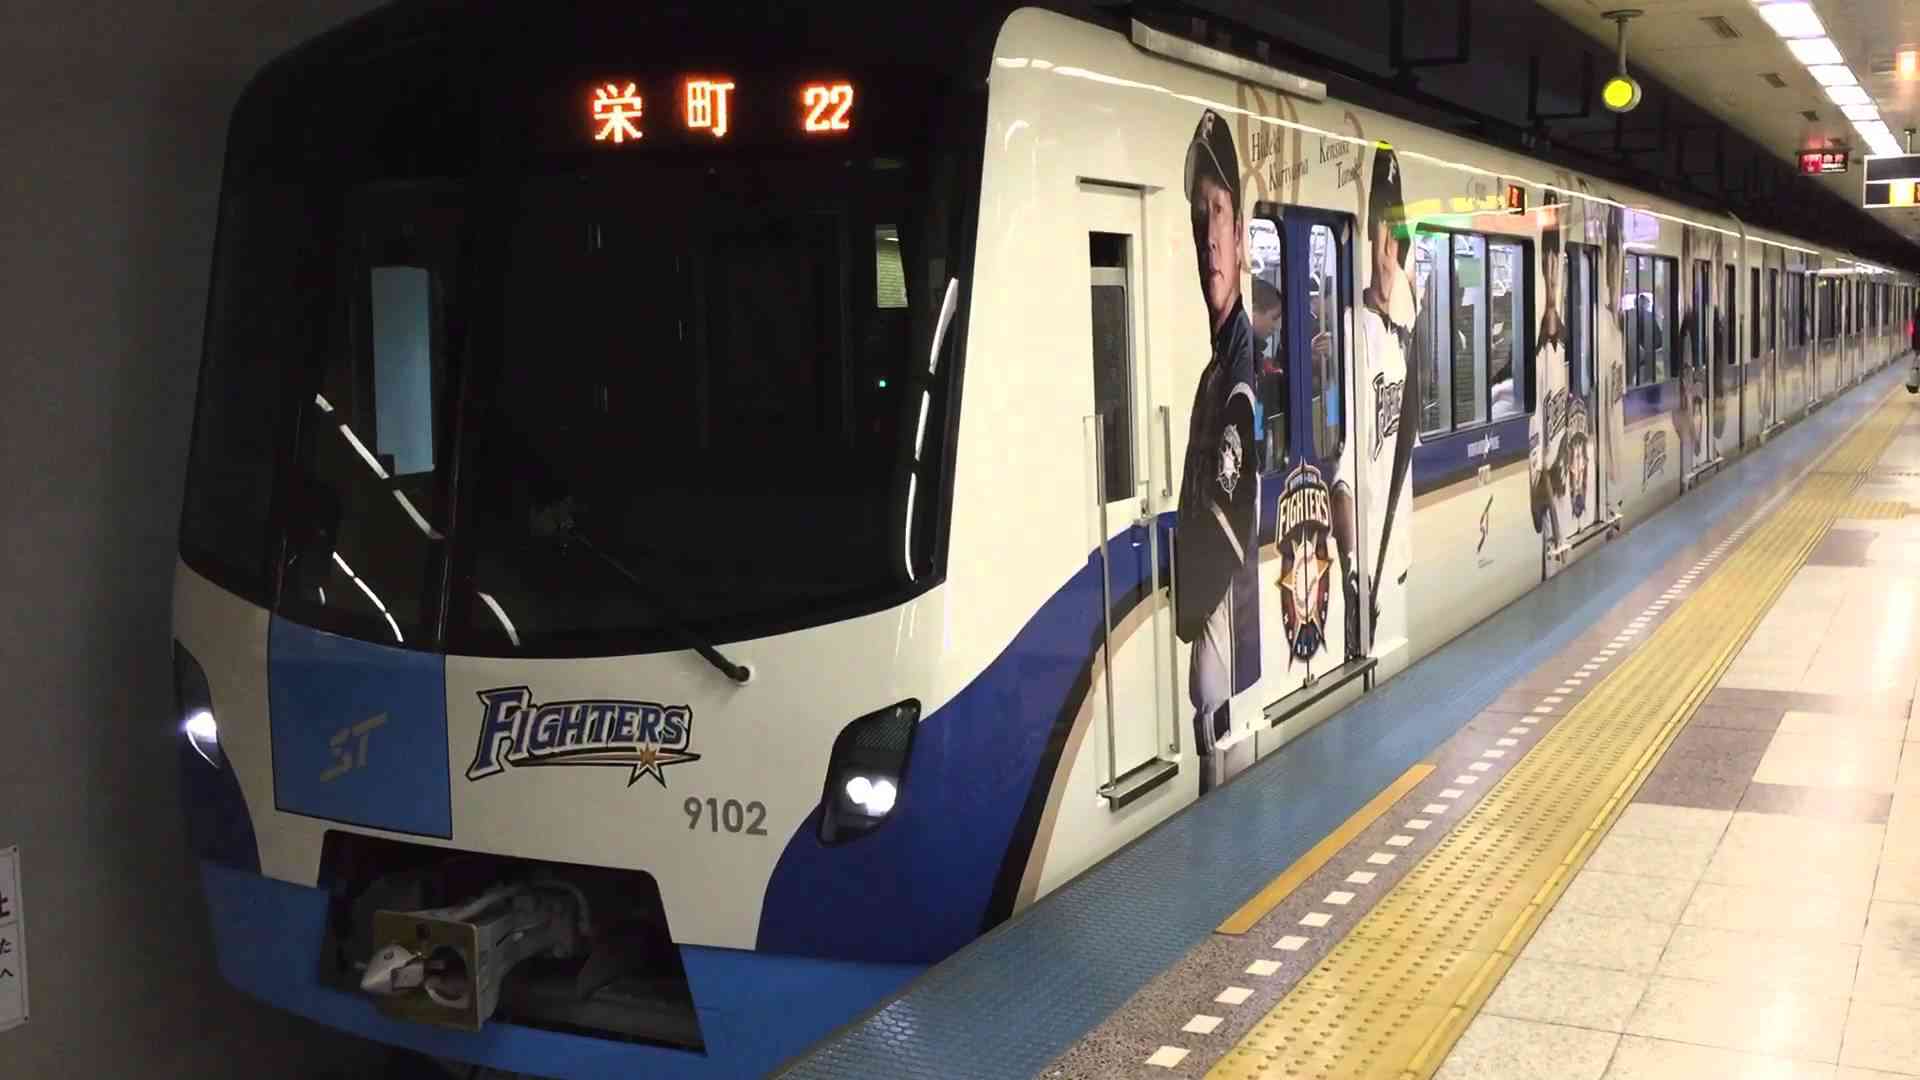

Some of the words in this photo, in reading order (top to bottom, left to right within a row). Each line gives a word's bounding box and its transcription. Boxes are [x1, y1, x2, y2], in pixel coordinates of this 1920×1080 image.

[804, 84, 854, 132] 22
[1279, 488, 1329, 543] FIGHTERS
[465, 686, 694, 781] FIGHTERS
[683, 797, 768, 837] 9102
